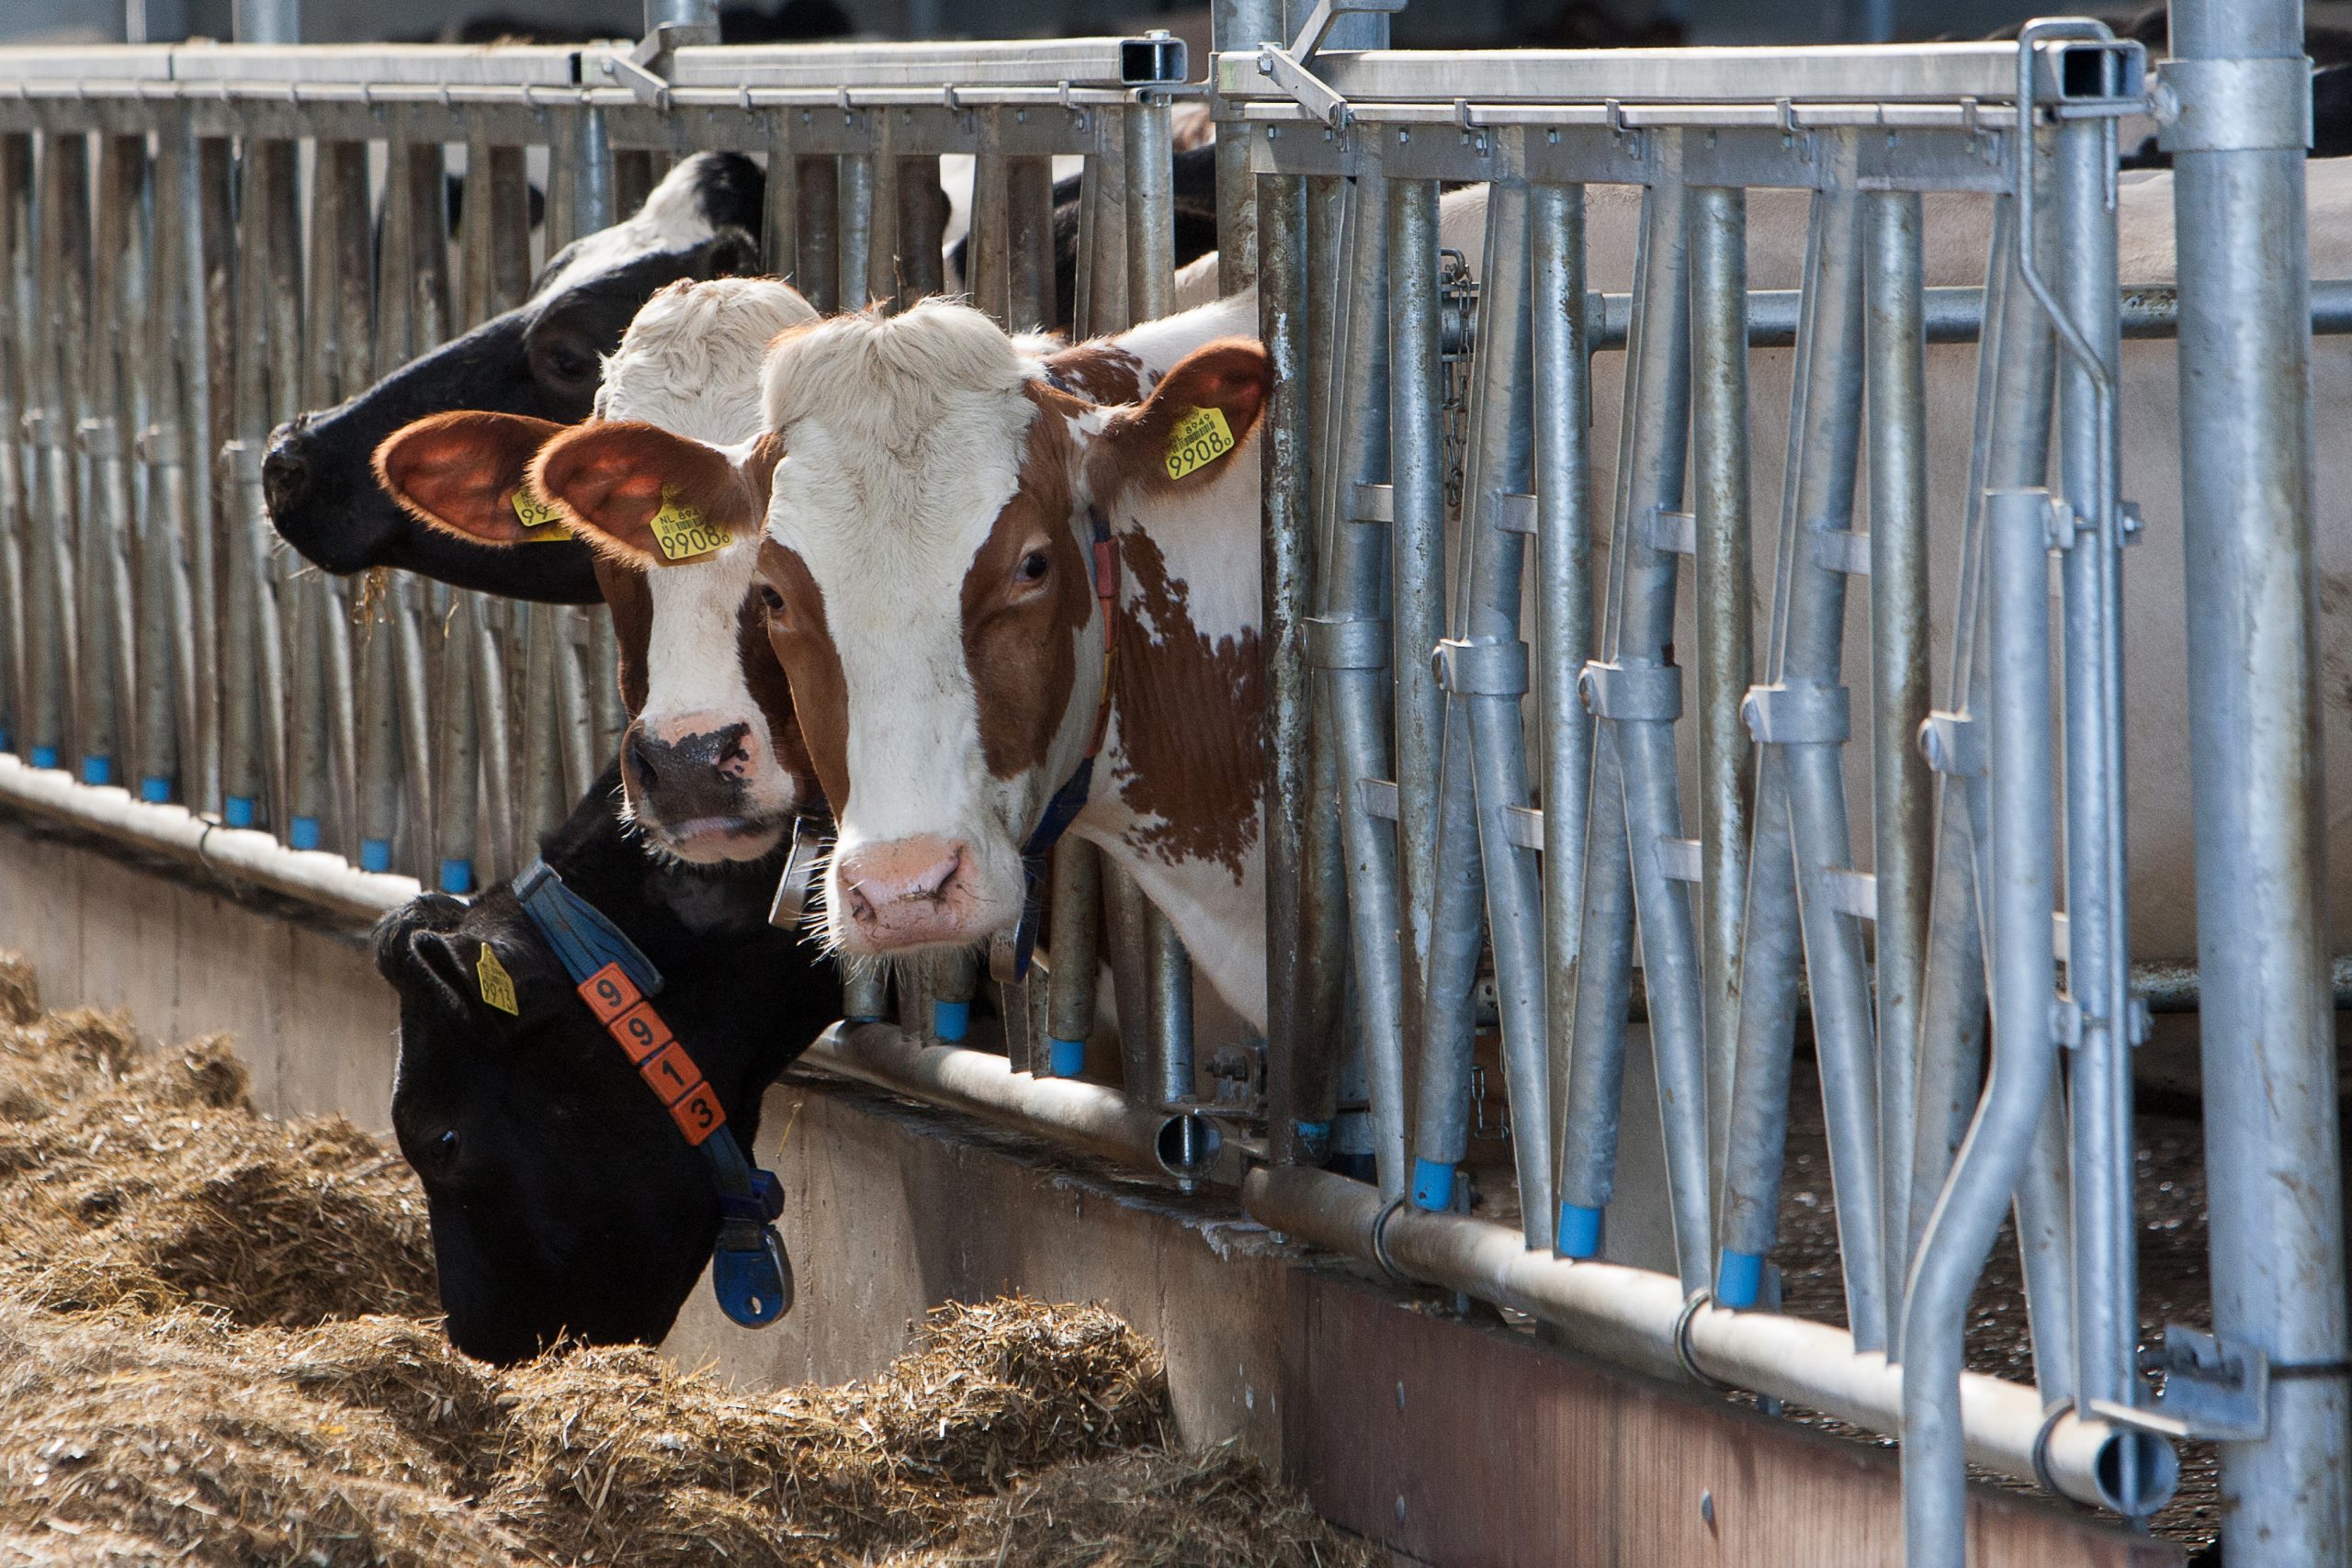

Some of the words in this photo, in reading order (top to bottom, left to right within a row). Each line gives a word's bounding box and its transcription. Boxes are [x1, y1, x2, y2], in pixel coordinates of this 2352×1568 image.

[1185, 413, 1210, 434] 8949
[521, 503, 548, 525] 99
[660, 515, 675, 525] NL
